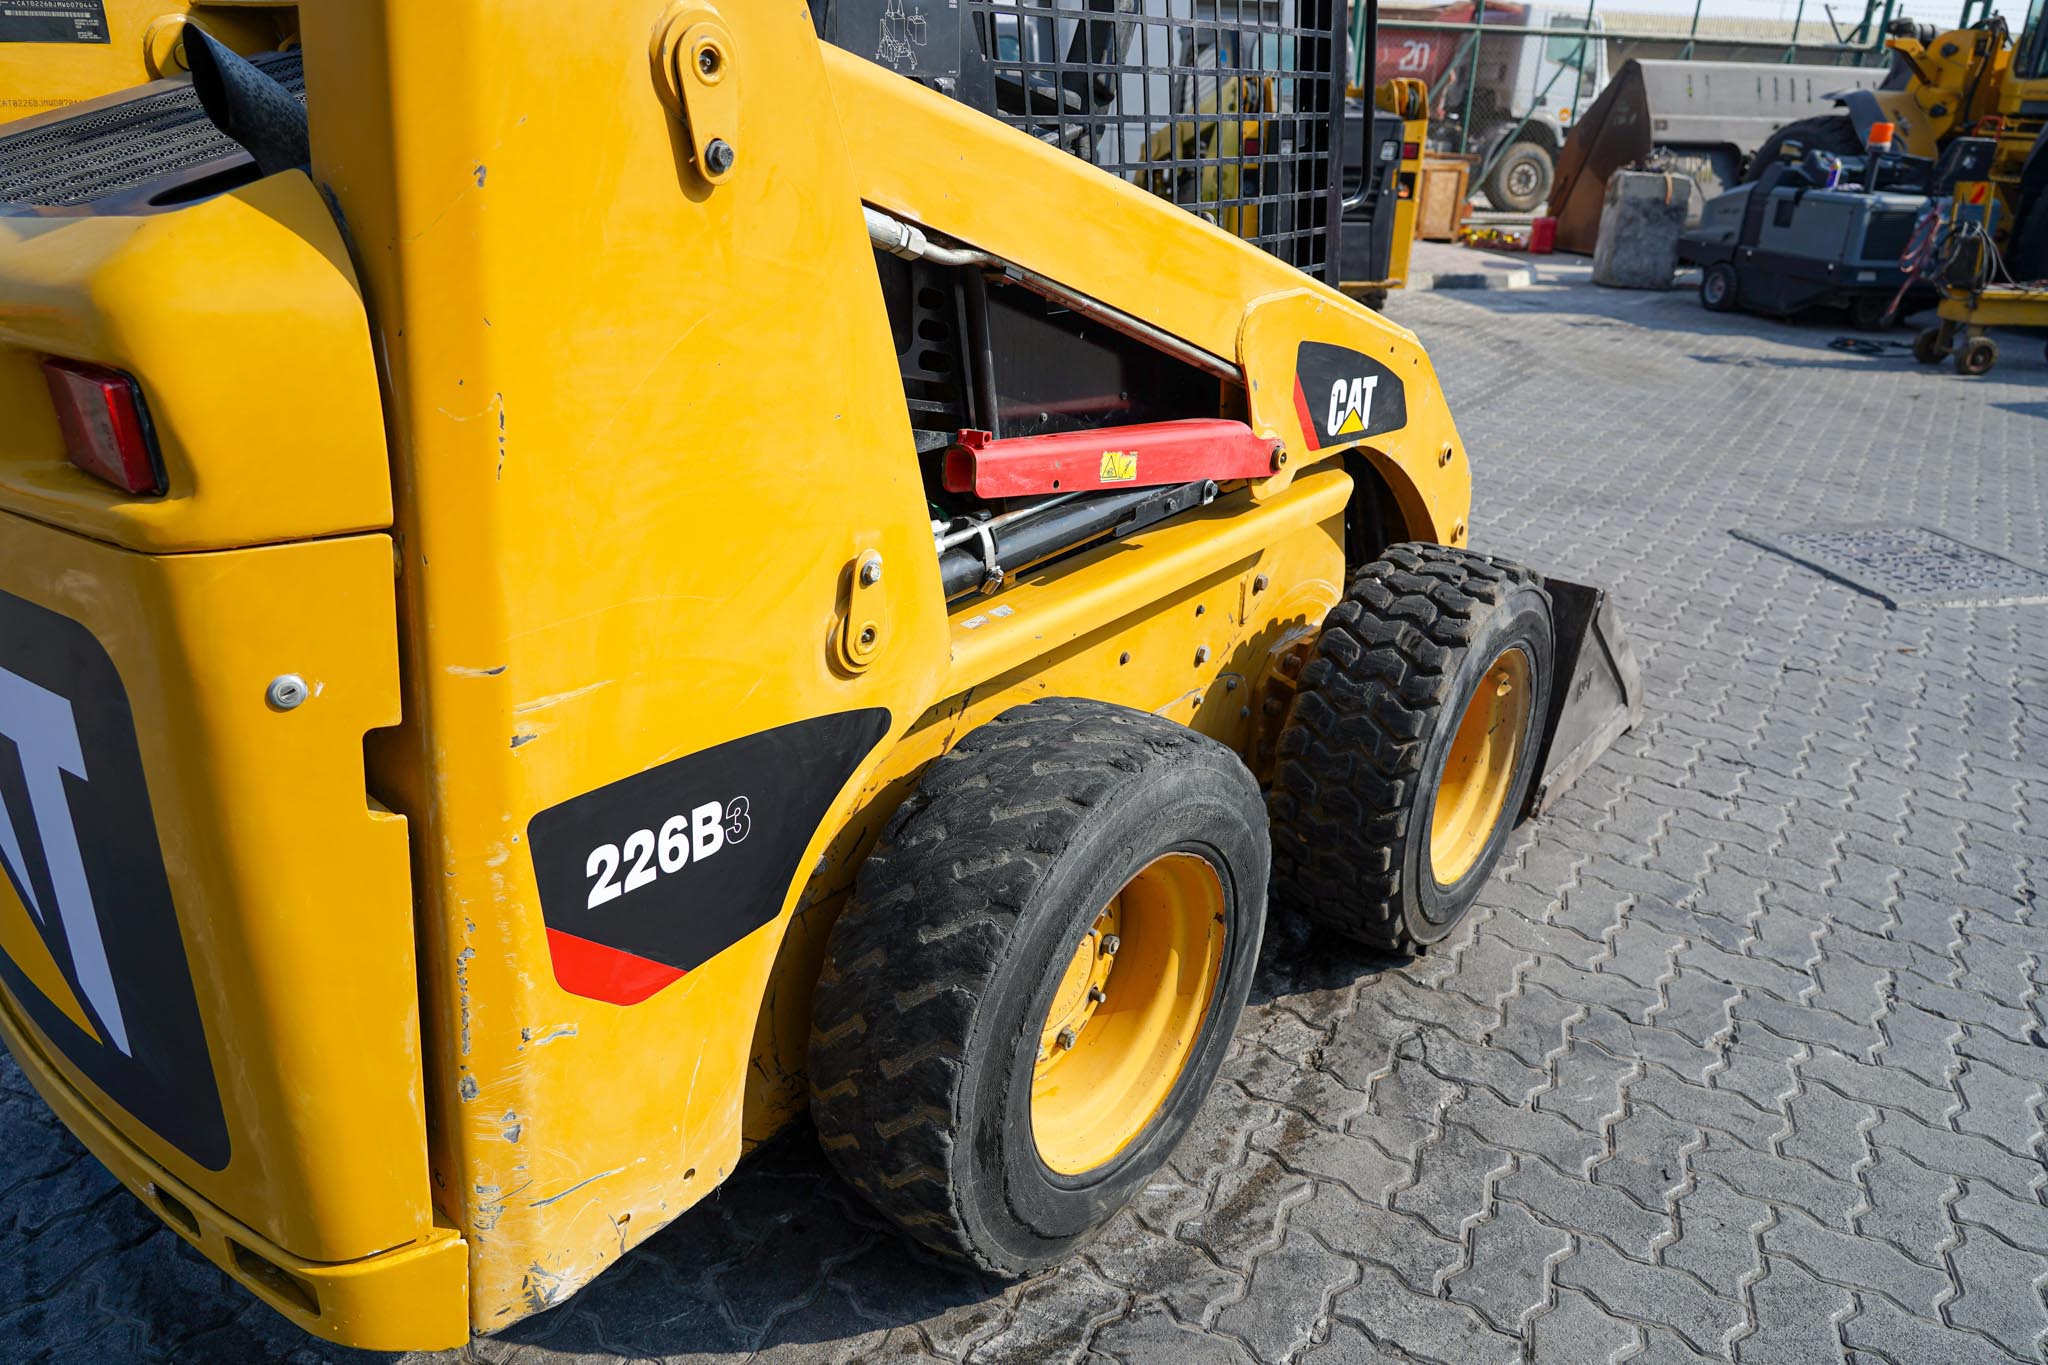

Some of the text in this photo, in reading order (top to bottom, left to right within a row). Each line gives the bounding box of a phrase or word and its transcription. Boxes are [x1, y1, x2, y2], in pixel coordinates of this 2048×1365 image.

[1398, 39, 1430, 71] 20
[1327, 376, 1379, 437] CAT
[0, 667, 133, 1057] T
